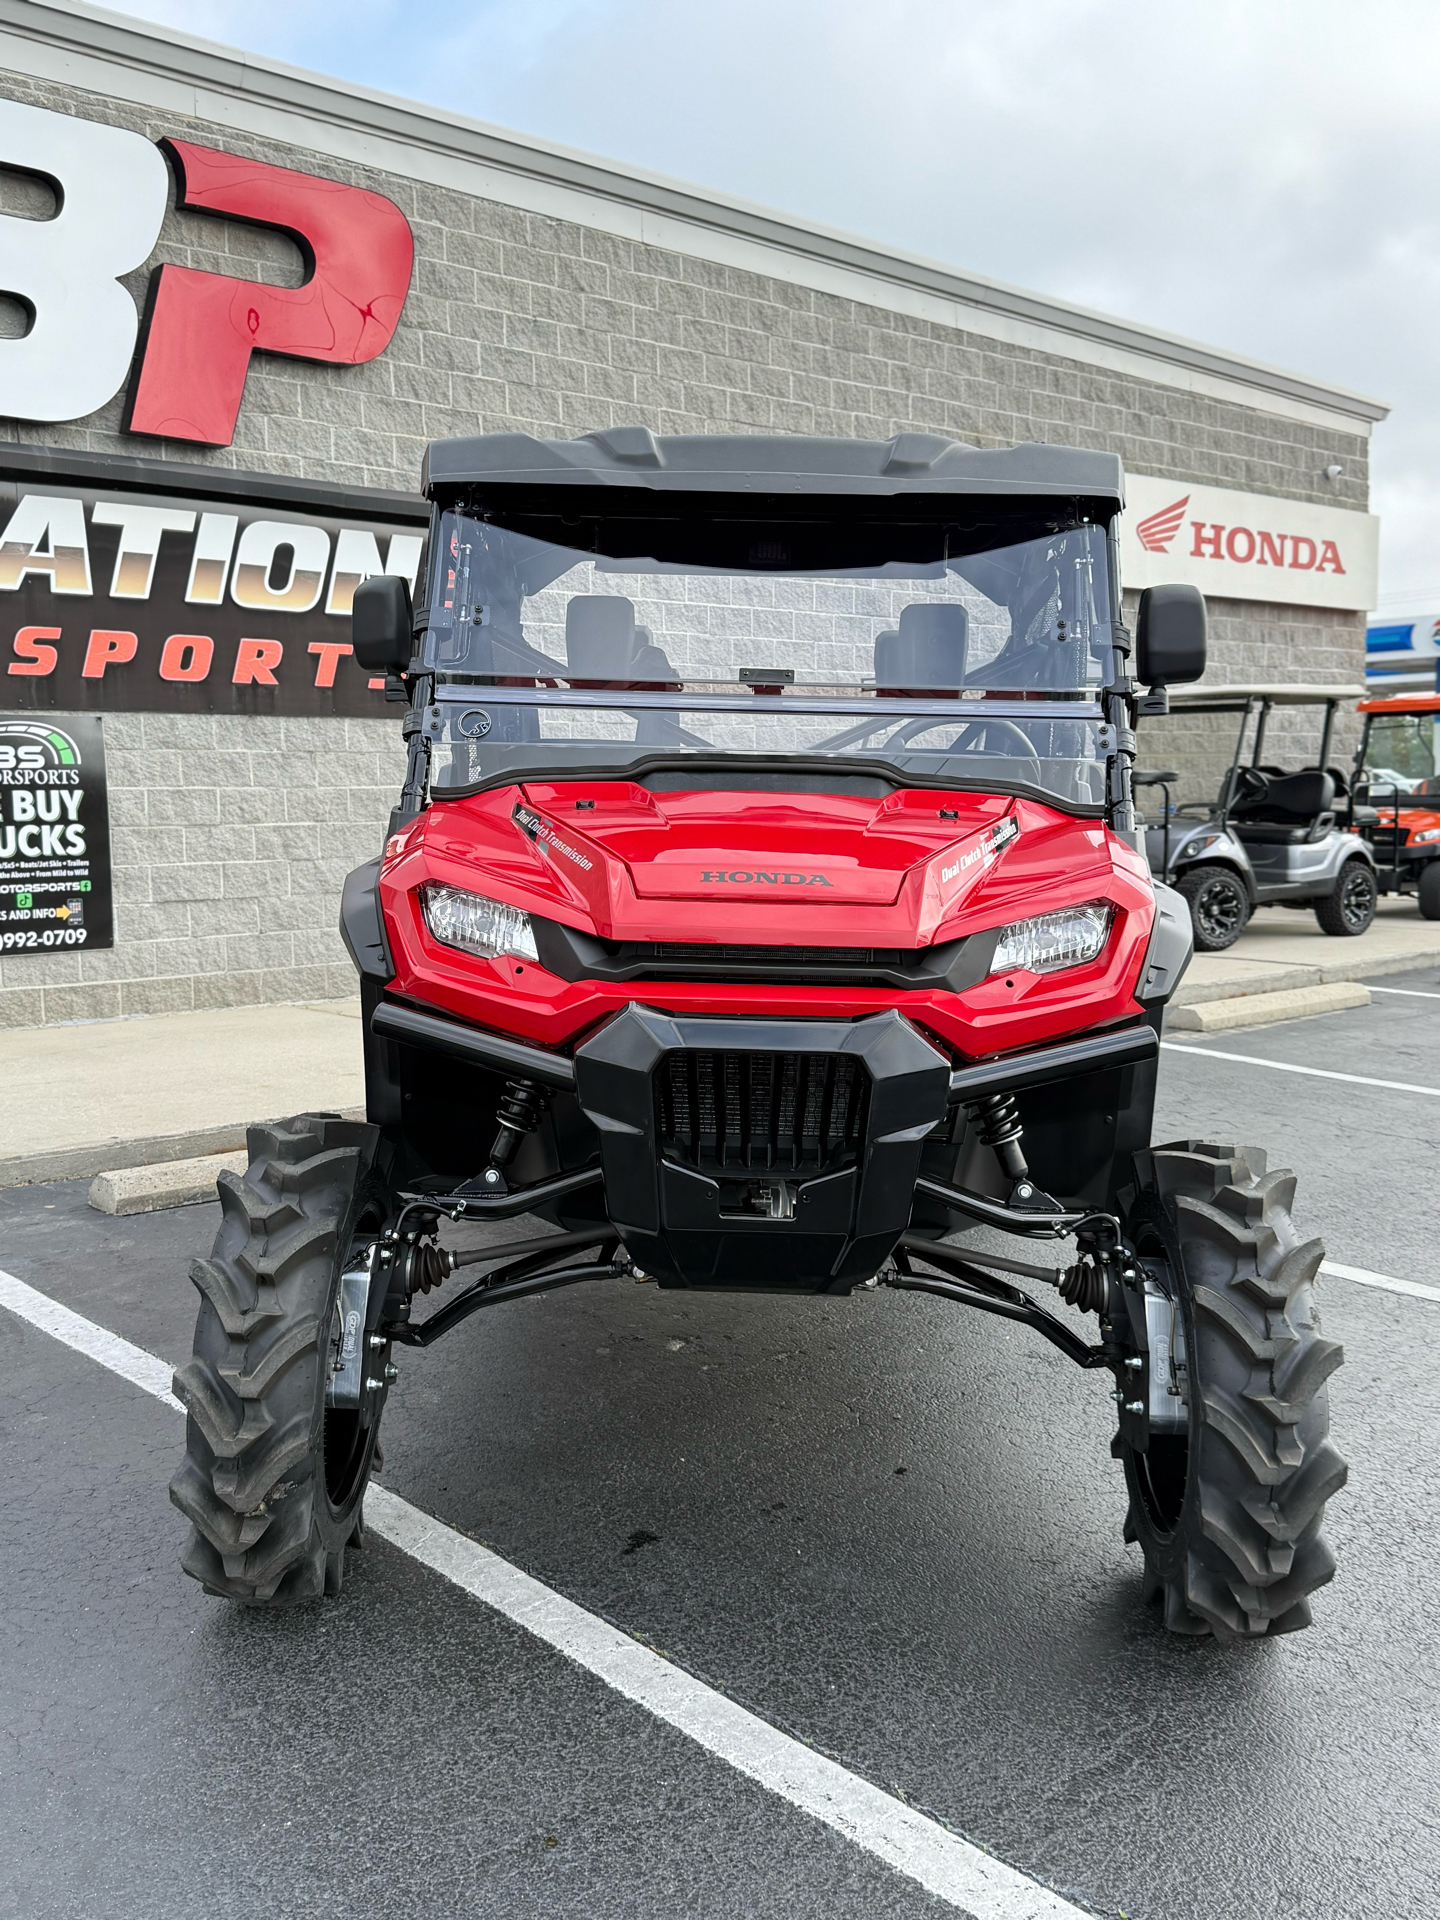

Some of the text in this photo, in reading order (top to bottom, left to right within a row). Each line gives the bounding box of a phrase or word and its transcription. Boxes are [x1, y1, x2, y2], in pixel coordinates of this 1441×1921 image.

[1190, 521, 1346, 575] HONDA
[8, 626, 408, 690] SPORT
[0, 769, 80, 785] RSPORTS
[12, 789, 85, 822] BUY
[515, 809, 593, 871] Dual Clutch Transmission
[941, 823, 1018, 884] Dual Clutch Transmission
[0, 882, 80, 894] OTORSPORTS
[700, 871, 834, 887] HONDA
[8, 909, 31, 920] AND
[32, 908, 56, 919] INFO
